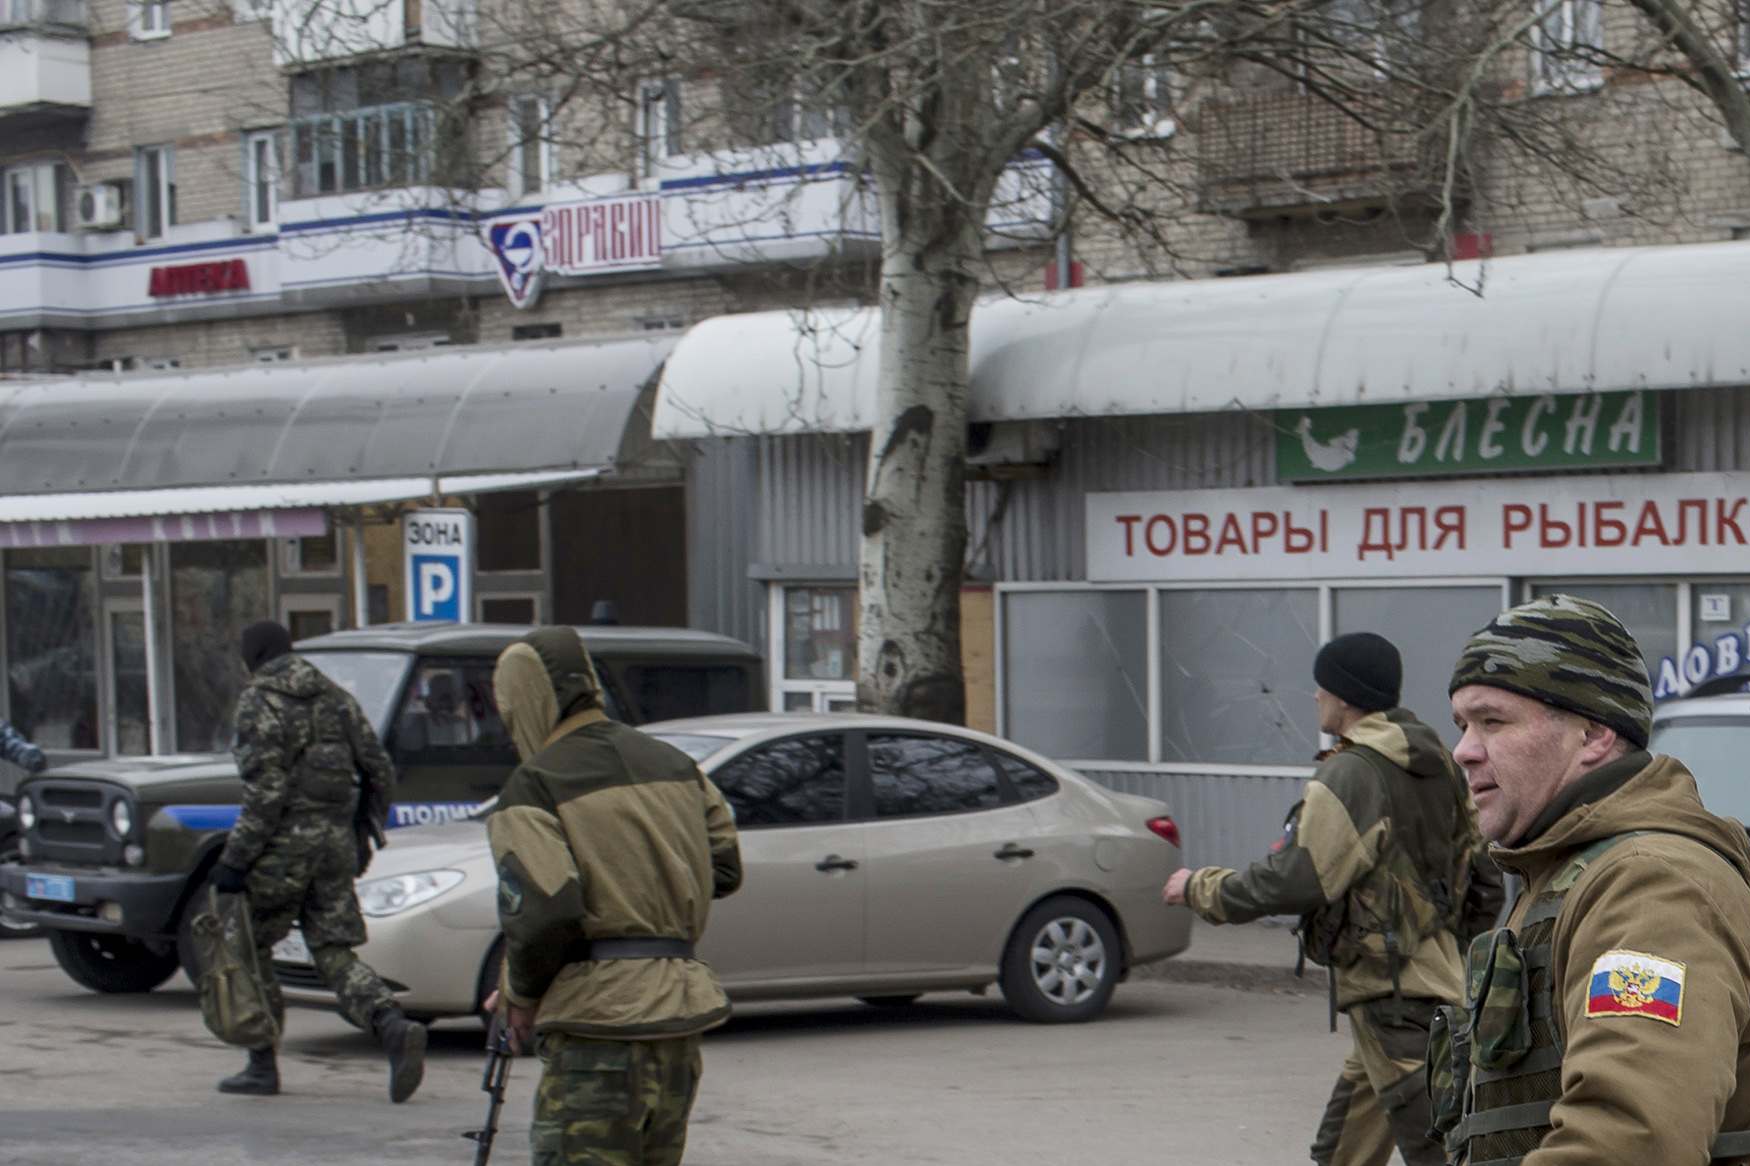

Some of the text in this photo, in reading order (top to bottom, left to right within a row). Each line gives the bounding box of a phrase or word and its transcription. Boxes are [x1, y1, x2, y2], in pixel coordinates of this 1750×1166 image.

[1398, 387, 1643, 464] БЛЕСНА
[408, 521, 462, 545] ЗОНА
[1115, 509, 1329, 557] ТОВАРЫ
[1357, 505, 1467, 561] ДЛЯ
[420, 562, 454, 616] P
